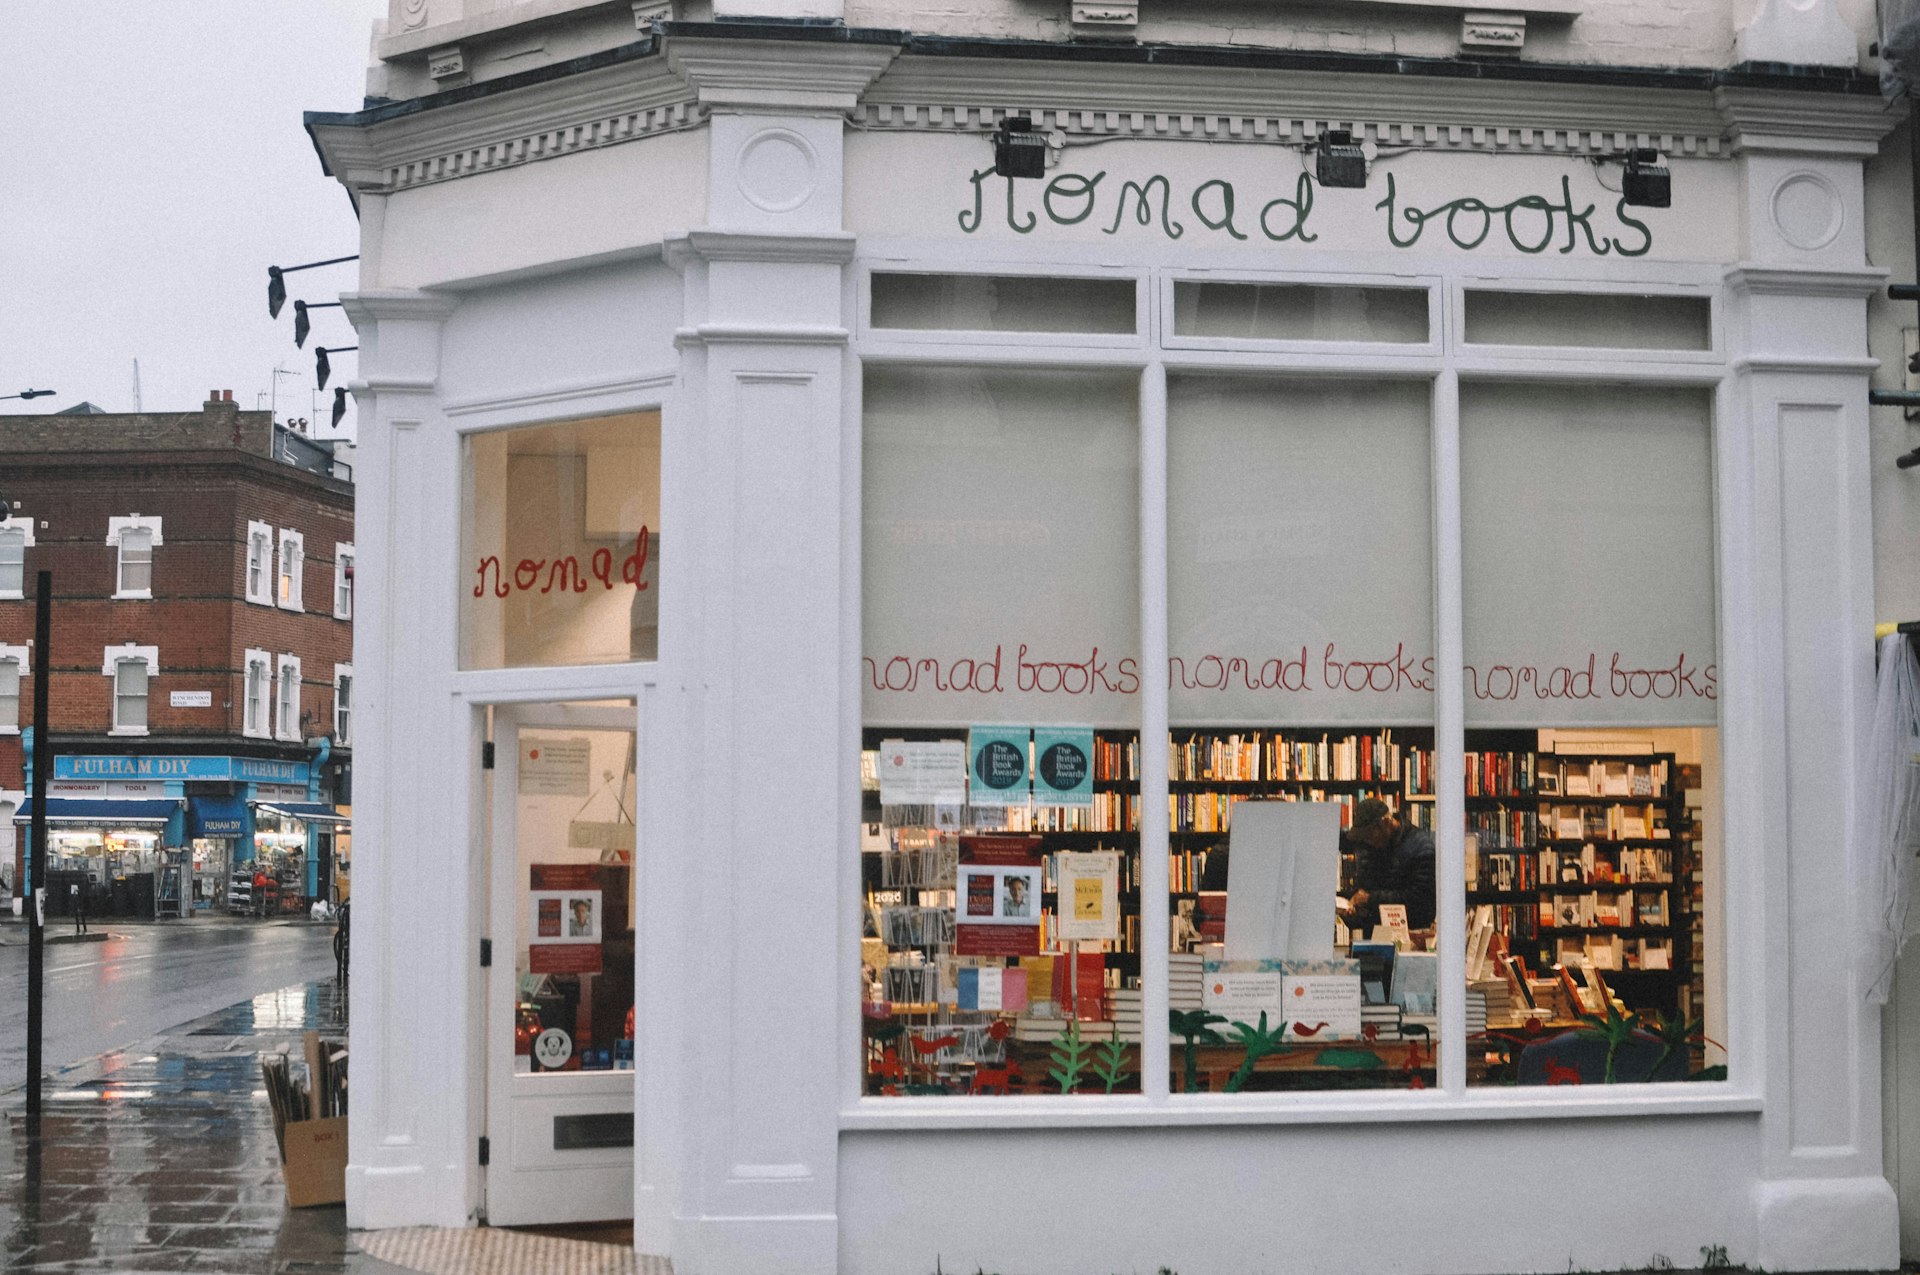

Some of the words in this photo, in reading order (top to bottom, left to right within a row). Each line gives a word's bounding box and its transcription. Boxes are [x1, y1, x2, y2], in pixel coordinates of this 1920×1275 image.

[958, 166, 1318, 242] nomad
[1376, 171, 1652, 257] books
[473, 525, 649, 598] nomad
[1018, 644, 1140, 694] books
[992, 744, 1008, 753] The
[1056, 746, 1071, 754] The
[992, 752, 1019, 761] British
[1056, 754, 1082, 763] British
[73, 759, 152, 774] FULHAM
[159, 759, 191, 774] DIY
[992, 761, 1013, 769] Book
[1056, 762, 1076, 770] Book
[242, 761, 279, 777] FULHAM
[281, 764, 295, 779] DIY
[992, 768, 1022, 776] Awards
[1055, 770, 1085, 778] Awards
[204, 820, 230, 830] FULHAM
[231, 821, 241, 829] DIY
